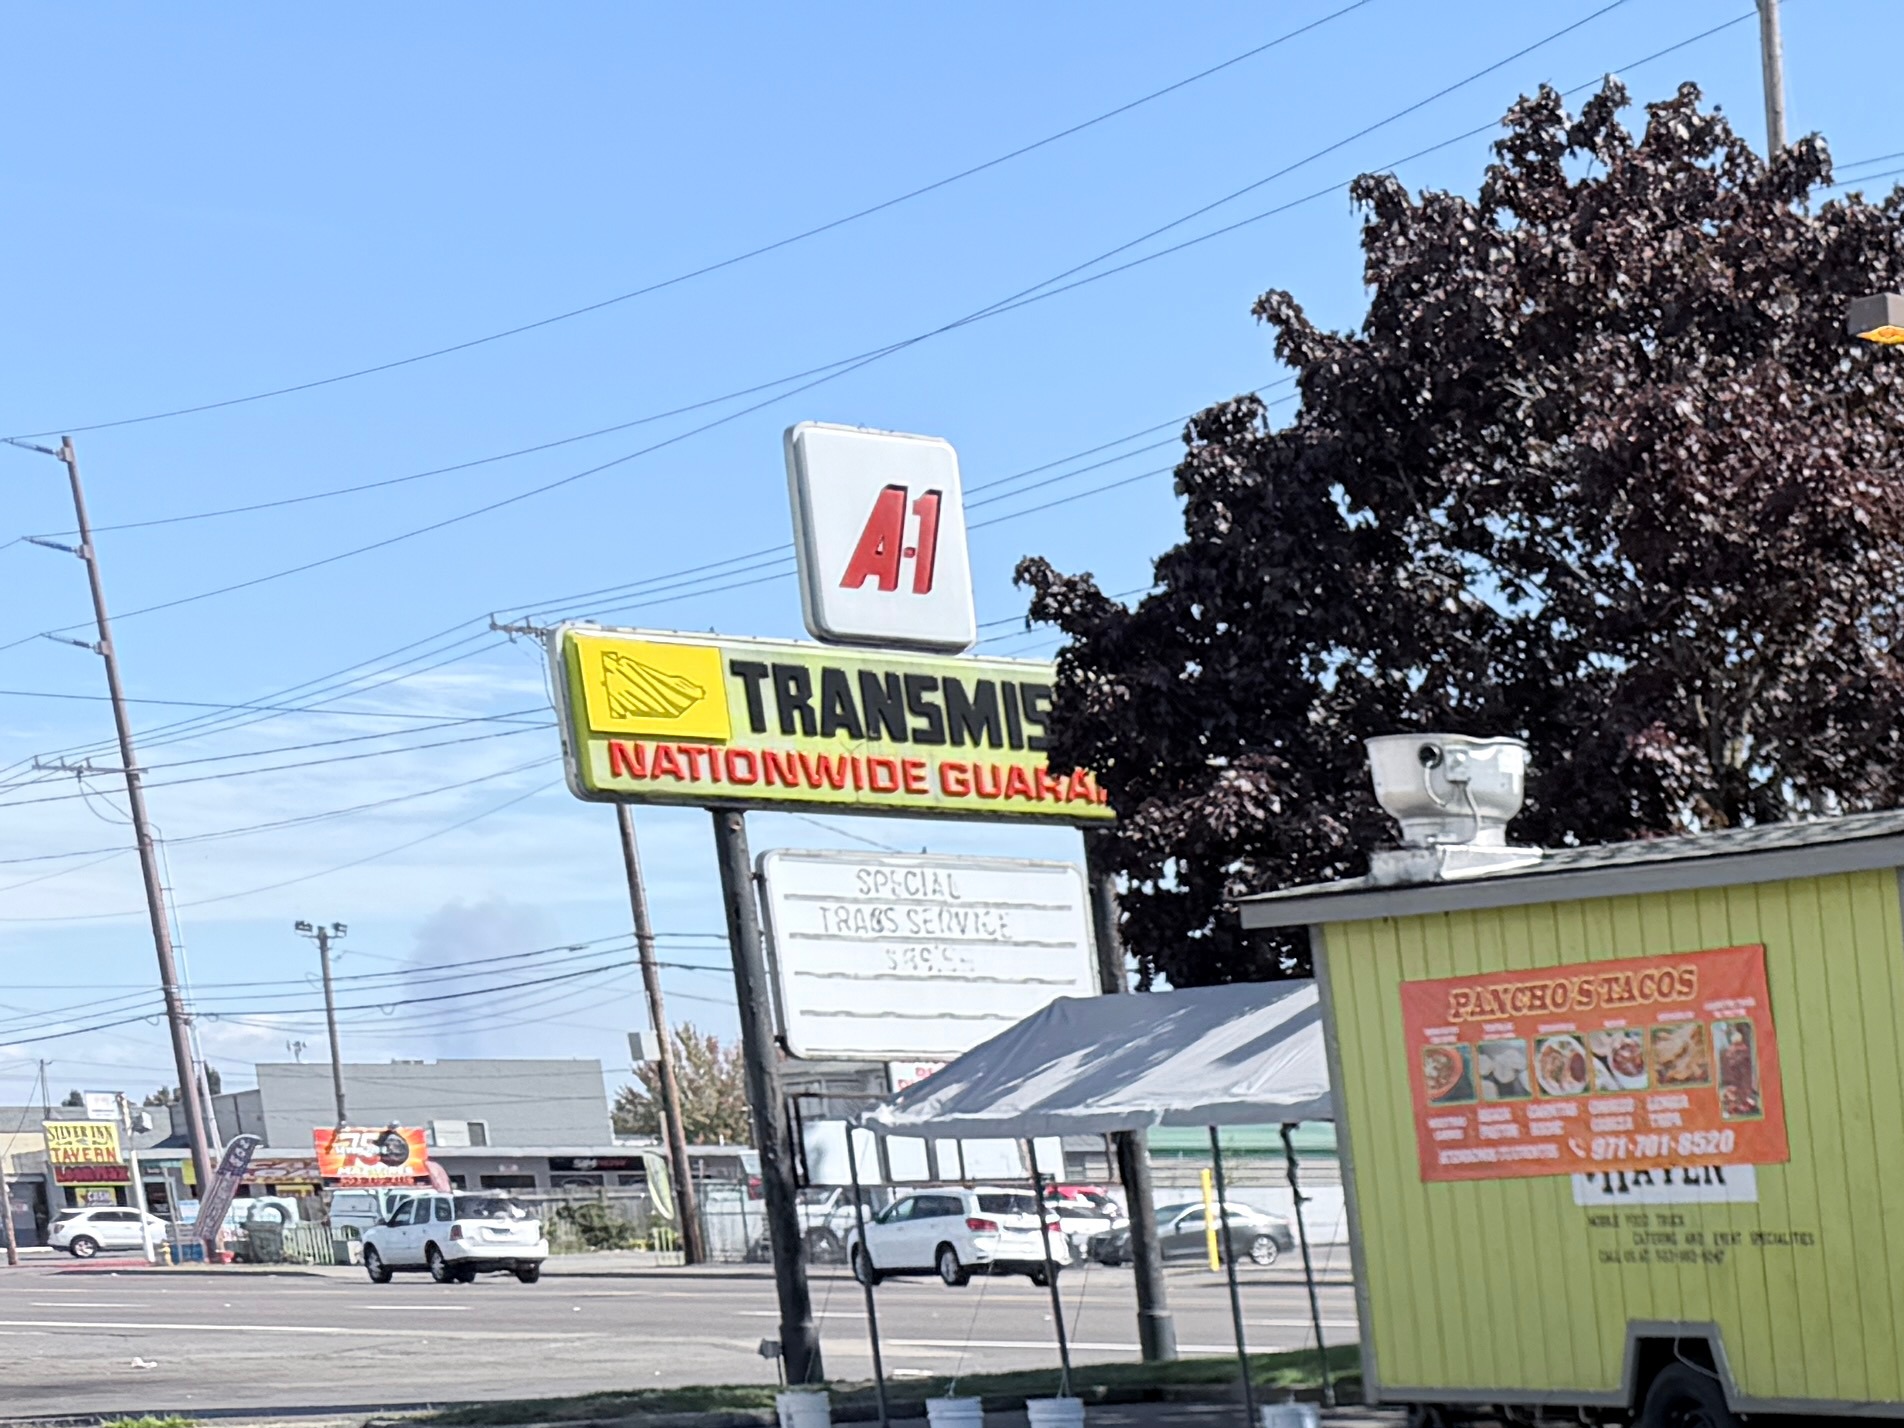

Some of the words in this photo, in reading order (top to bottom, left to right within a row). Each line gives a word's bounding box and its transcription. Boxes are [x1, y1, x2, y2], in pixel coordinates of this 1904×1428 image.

[839, 483, 944, 594] A-1
[729, 659, 1054, 752] TRANSMIS
[608, 740, 928, 795] NATIONWIDE
[939, 761, 1107, 806] GUARA
[856, 868, 961, 900] SPECIAL
[906, 907, 1013, 940] SERVICE
[1448, 975, 1596, 1022] PANCHO'S
[1599, 965, 1698, 1008] TACOS
[47, 1125, 88, 1141] SILVER
[90, 1125, 114, 1141] INN
[50, 1147, 117, 1163] TAVERN
